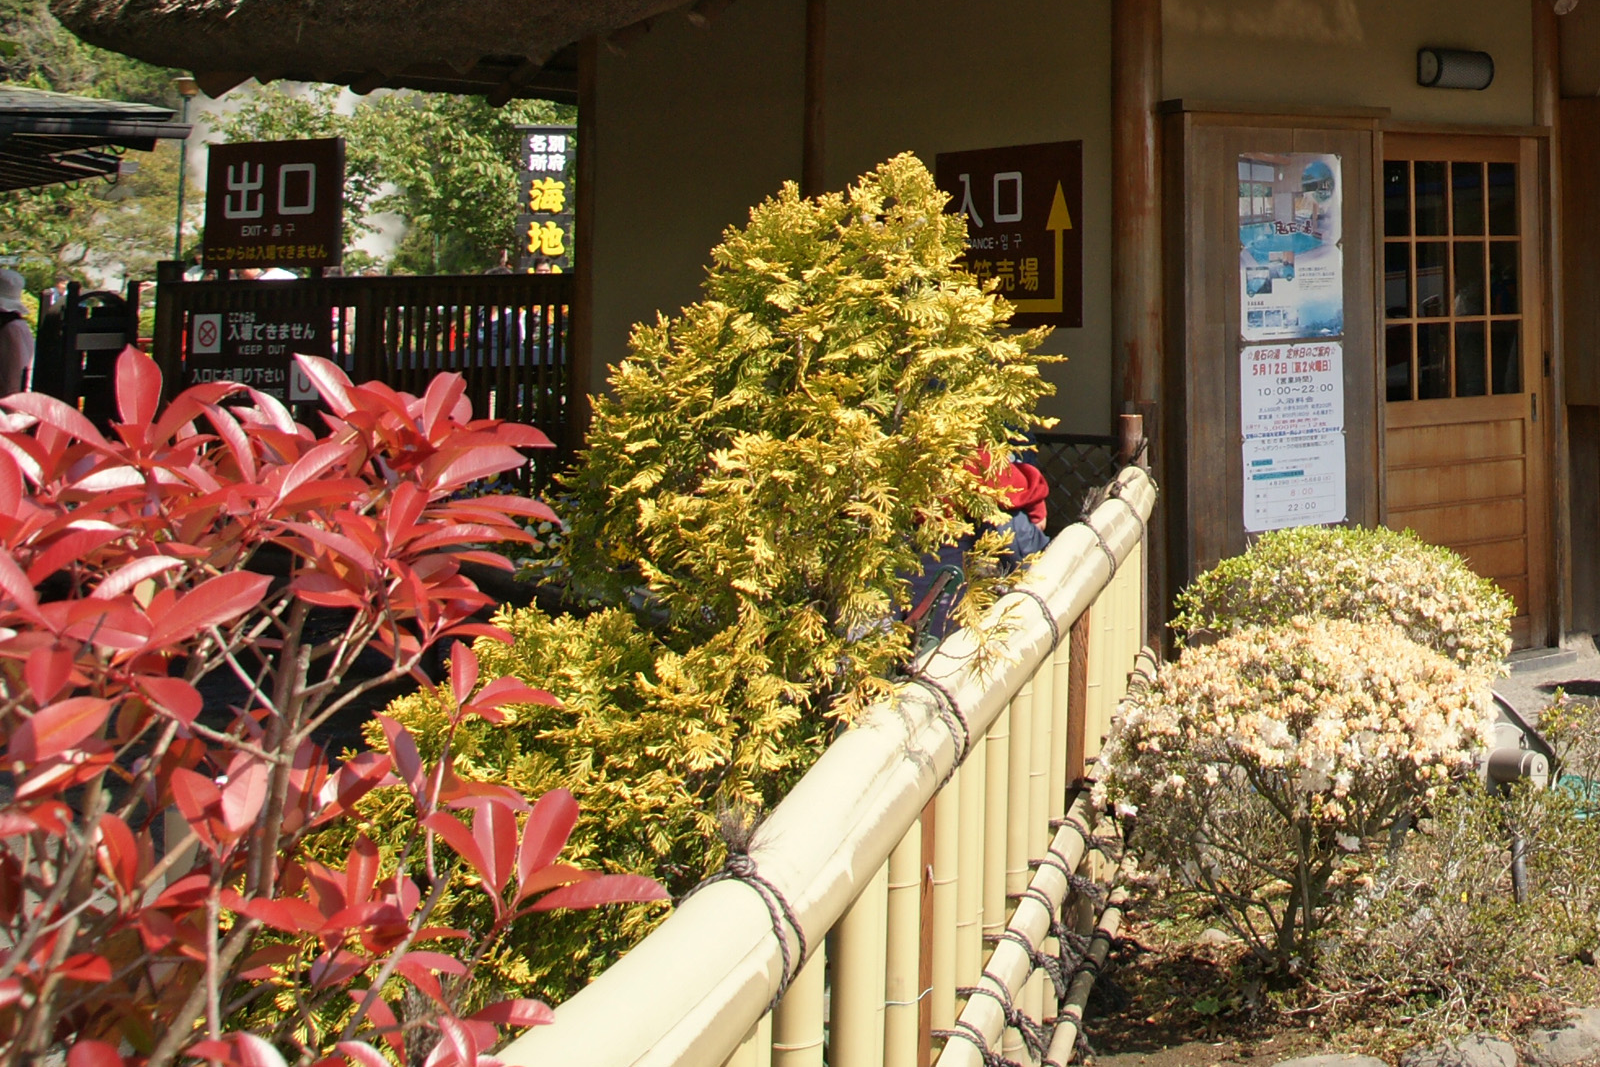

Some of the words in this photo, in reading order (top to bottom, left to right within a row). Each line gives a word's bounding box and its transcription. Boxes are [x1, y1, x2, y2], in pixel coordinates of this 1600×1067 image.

[528, 135, 548, 172] 名所
[224, 161, 316, 219] 出口
[959, 171, 1023, 229] 入口
[527, 176, 566, 273] 海地
[239, 345, 263, 354] KEEP
[268, 345, 286, 354] OUT
[1253, 362, 1288, 376] 5月12日
